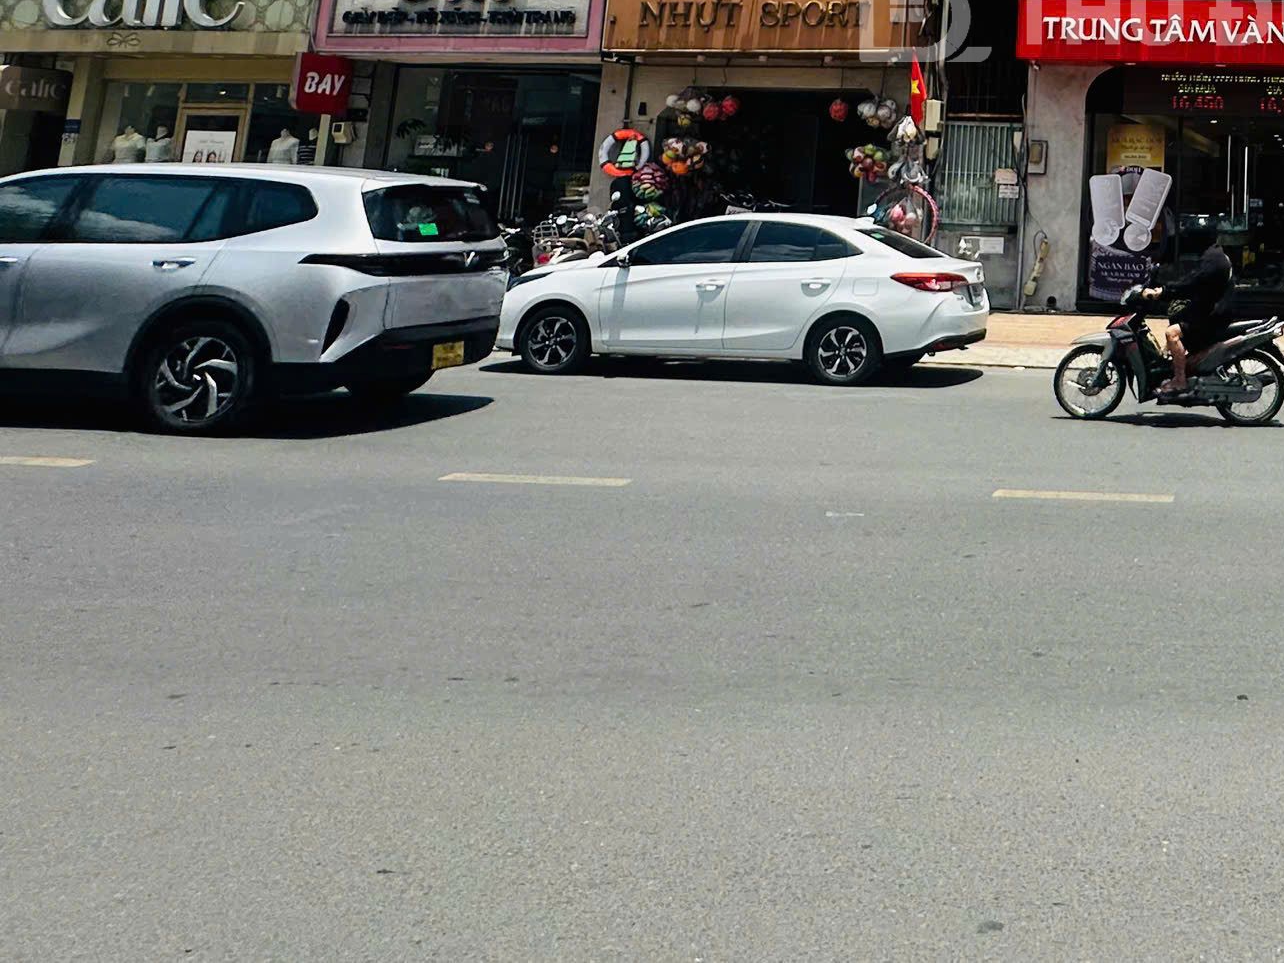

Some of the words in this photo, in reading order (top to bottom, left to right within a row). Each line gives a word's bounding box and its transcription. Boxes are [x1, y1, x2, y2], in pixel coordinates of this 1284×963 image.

[759, 0, 872, 29] SPORT
[1043, 16, 1144, 42] TRUNG
[1150, 13, 1217, 43] TÂM
[303, 71, 346, 96] BAY
